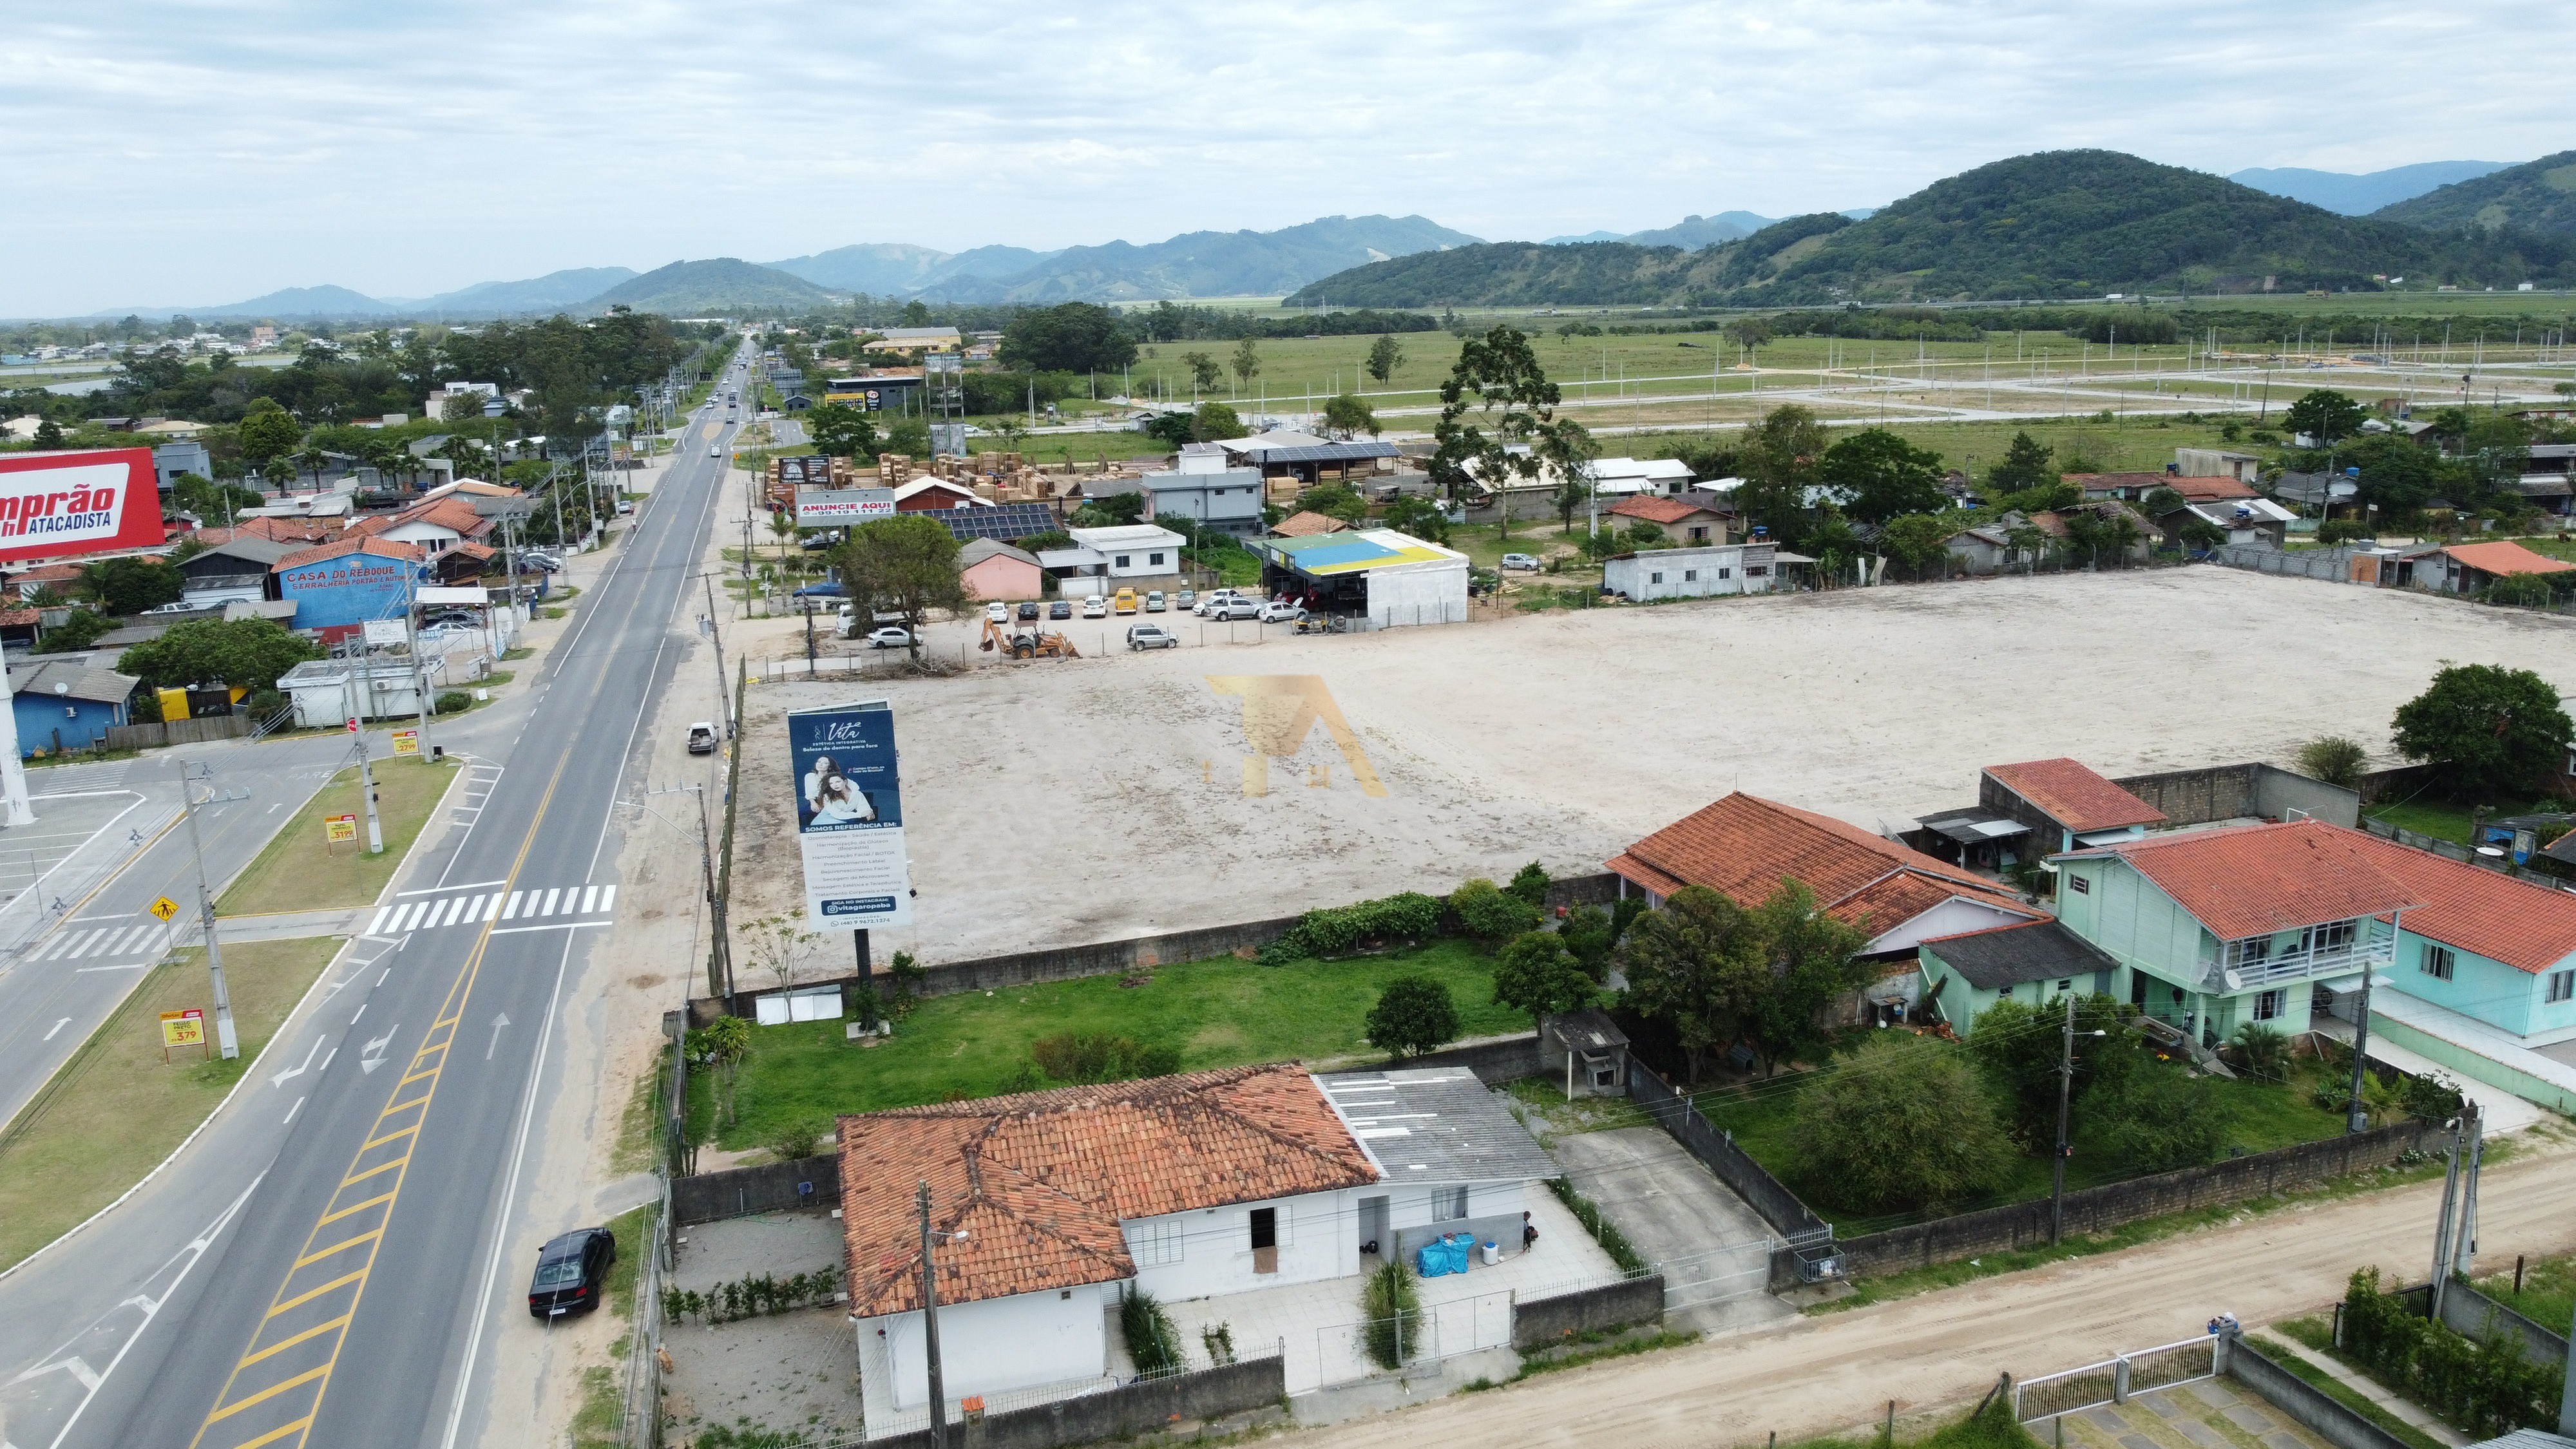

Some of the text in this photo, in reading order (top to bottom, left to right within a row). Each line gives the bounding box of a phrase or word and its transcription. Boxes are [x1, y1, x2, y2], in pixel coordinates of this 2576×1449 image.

[803, 503, 857, 511] ANUNCIE
[28, 512, 111, 534] ATACADISTA
[287, 566, 395, 582] CASA DO REBOQUE
[292, 580, 350, 589] SERRALHERIA
